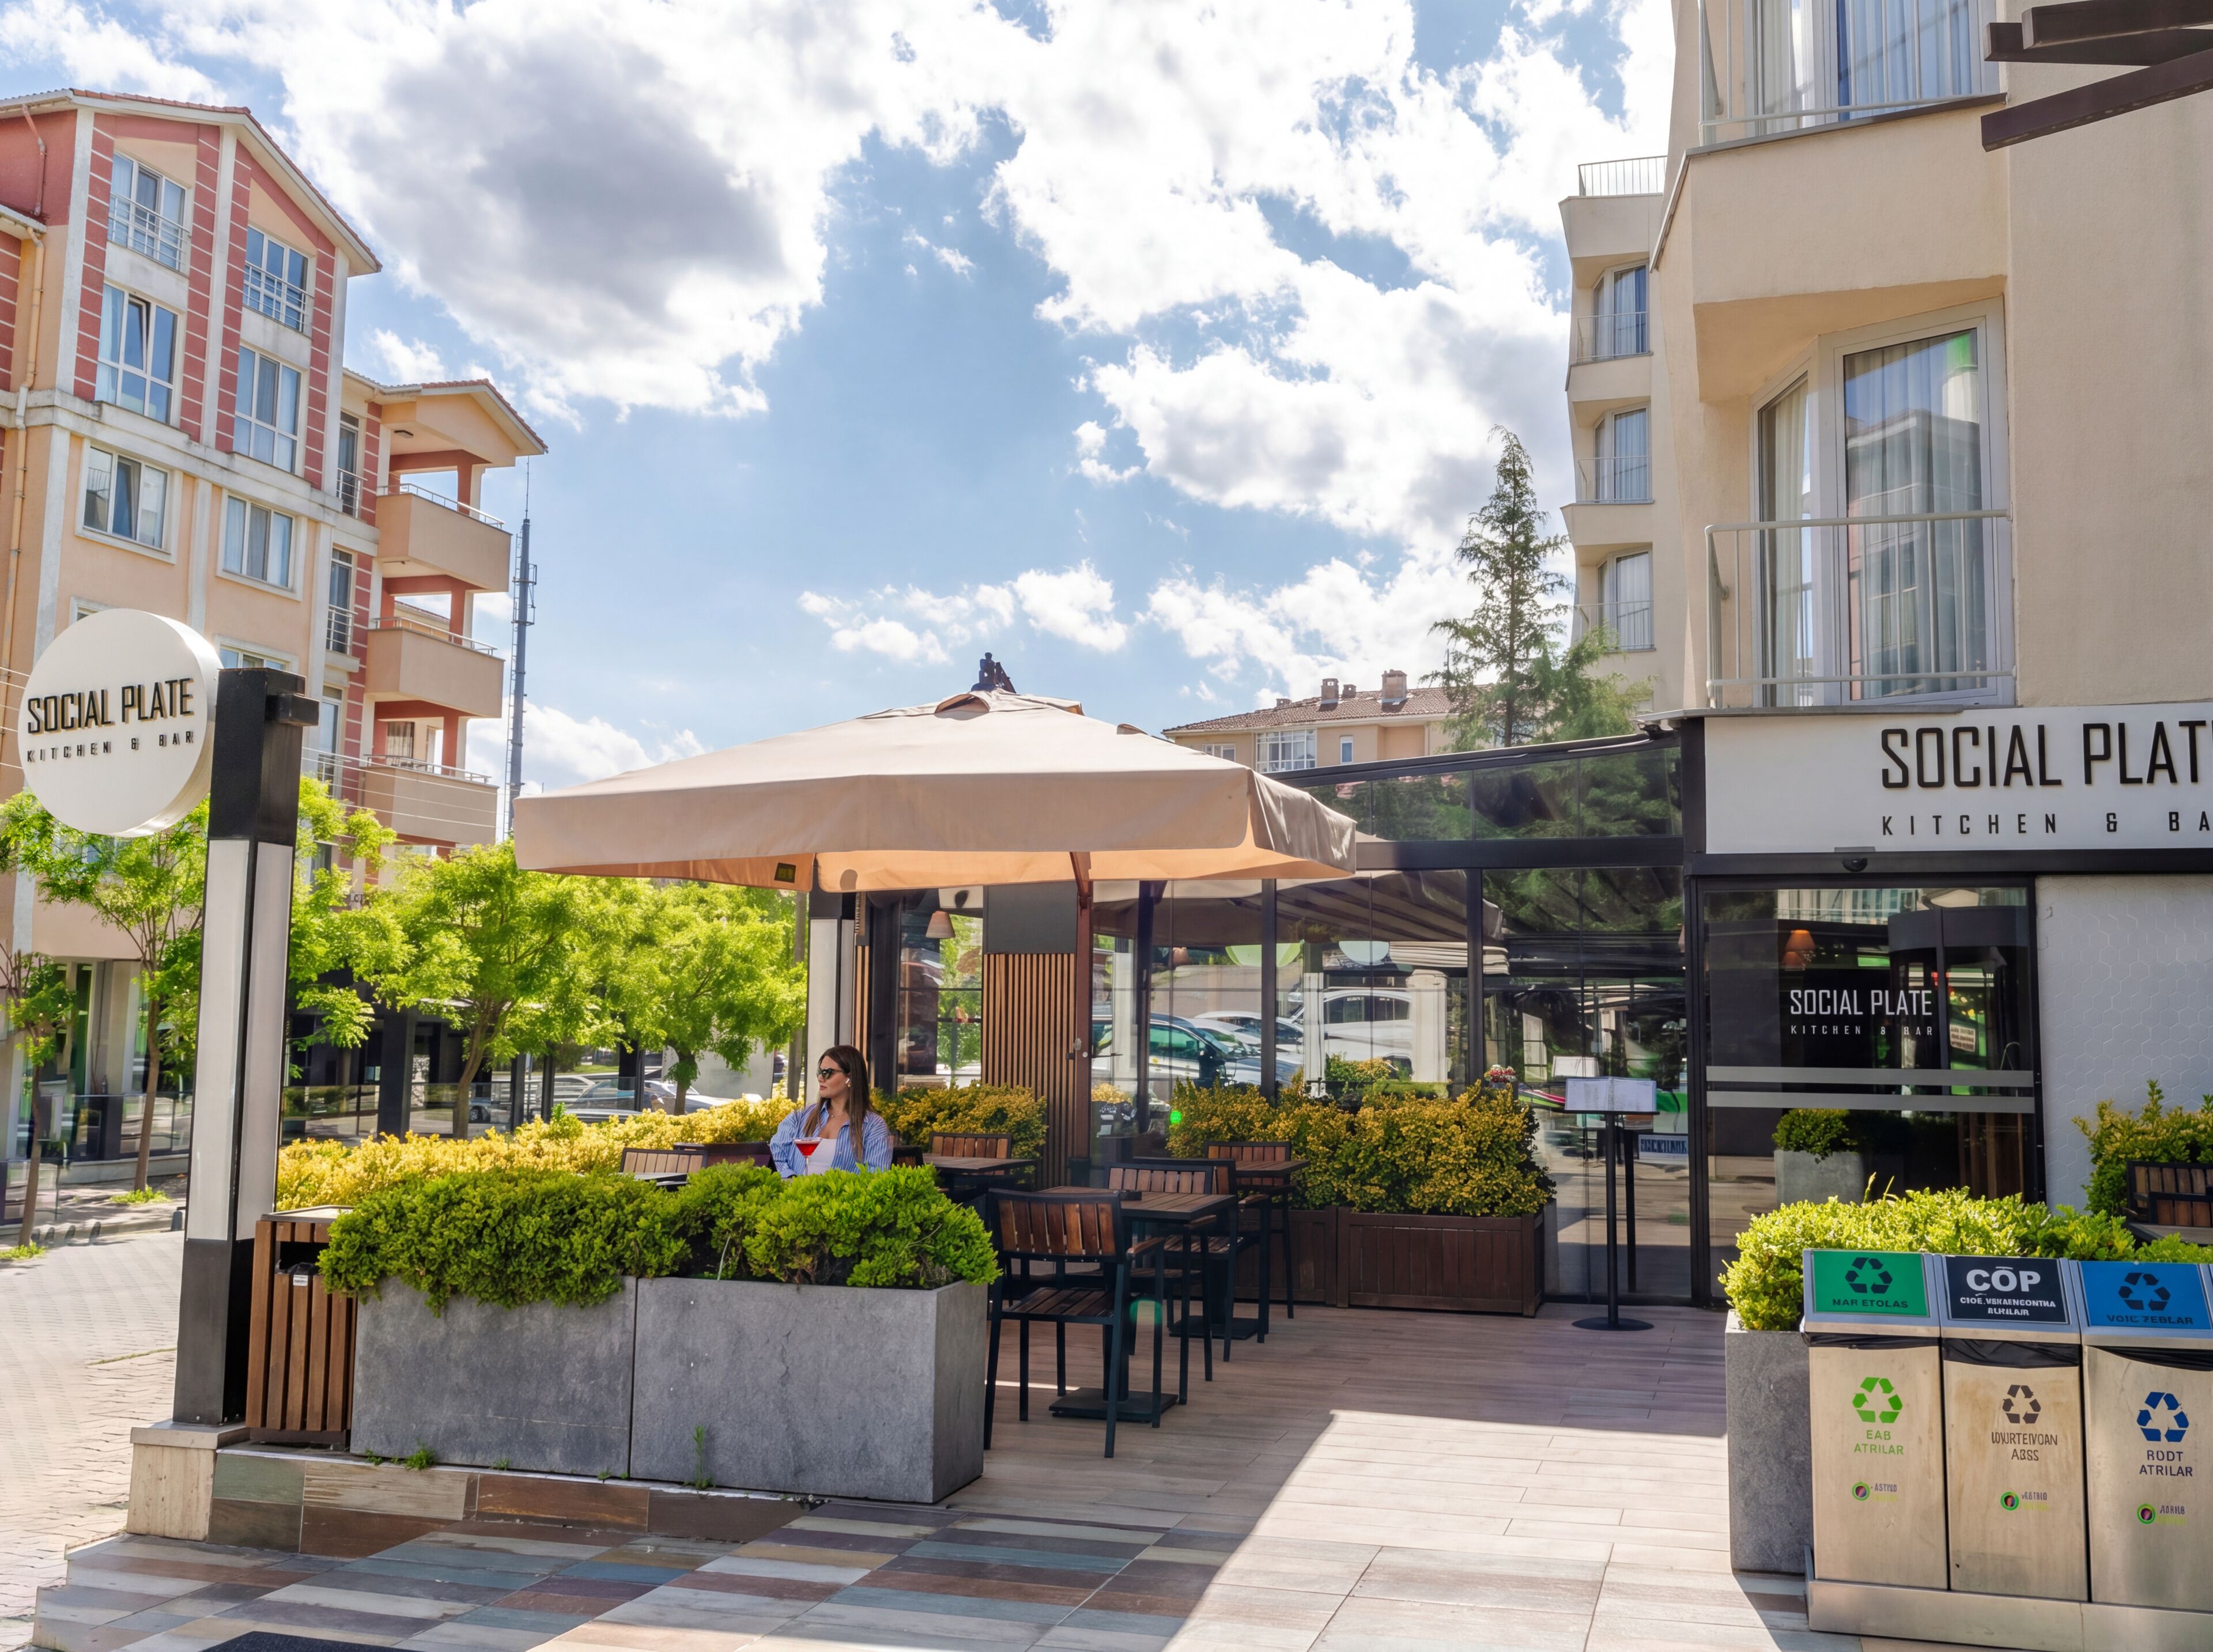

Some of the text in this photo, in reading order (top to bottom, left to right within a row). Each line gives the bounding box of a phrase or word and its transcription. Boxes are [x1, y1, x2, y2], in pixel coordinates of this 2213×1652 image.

[27, 678, 195, 734] SOCIAL PLATE
[27, 731, 192, 762] KITCHEN & BAR
[1882, 720, 2213, 788] SOCIAL PLAT
[1882, 814, 2056, 836] KITCHEN
[2106, 812, 2118, 833] &
[1790, 989, 1932, 1015] SOCIAL PLATE
[1791, 1025, 1861, 1035] KITCHEN
[1904, 1026, 1933, 1035] BAR
[1866, 1430, 1891, 1441] EAB
[1853, 1443, 1904, 1456] ATRILAR
[2139, 1464, 2193, 1477] ATRILAR
